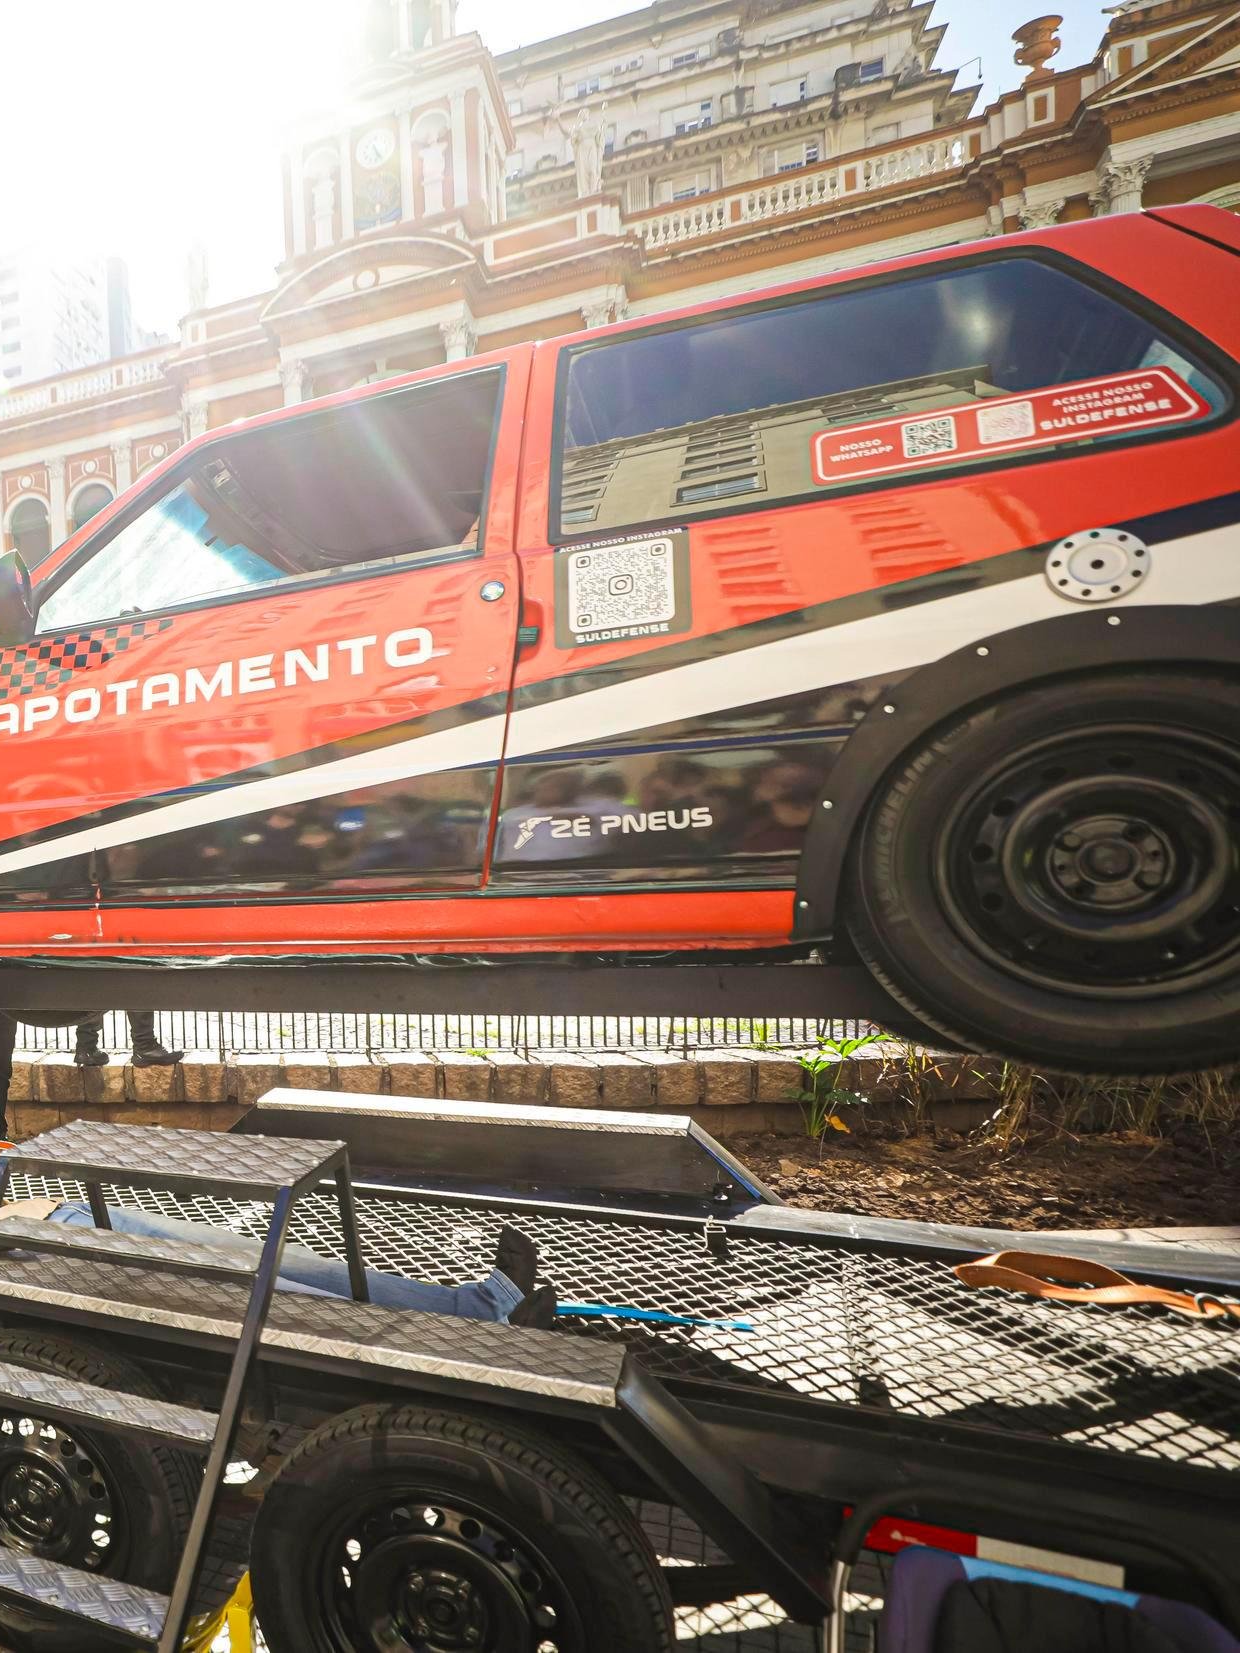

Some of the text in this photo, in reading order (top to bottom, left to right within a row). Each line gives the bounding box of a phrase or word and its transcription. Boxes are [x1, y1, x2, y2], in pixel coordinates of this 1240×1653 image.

[1052, 381, 1154, 406] ACESSE NOSSO
[1063, 392, 1145, 413] INSTAGRAM
[1040, 398, 1172, 431] SULDEFENSE
[829, 445, 894, 462] WHATSAPP
[840, 438, 882, 452] NOSSO
[559, 527, 683, 553] ACESSE NOSSO INSTAGRAM
[575, 622, 670, 644] SULDEFENSE
[600, 806, 713, 835] PNEUS
